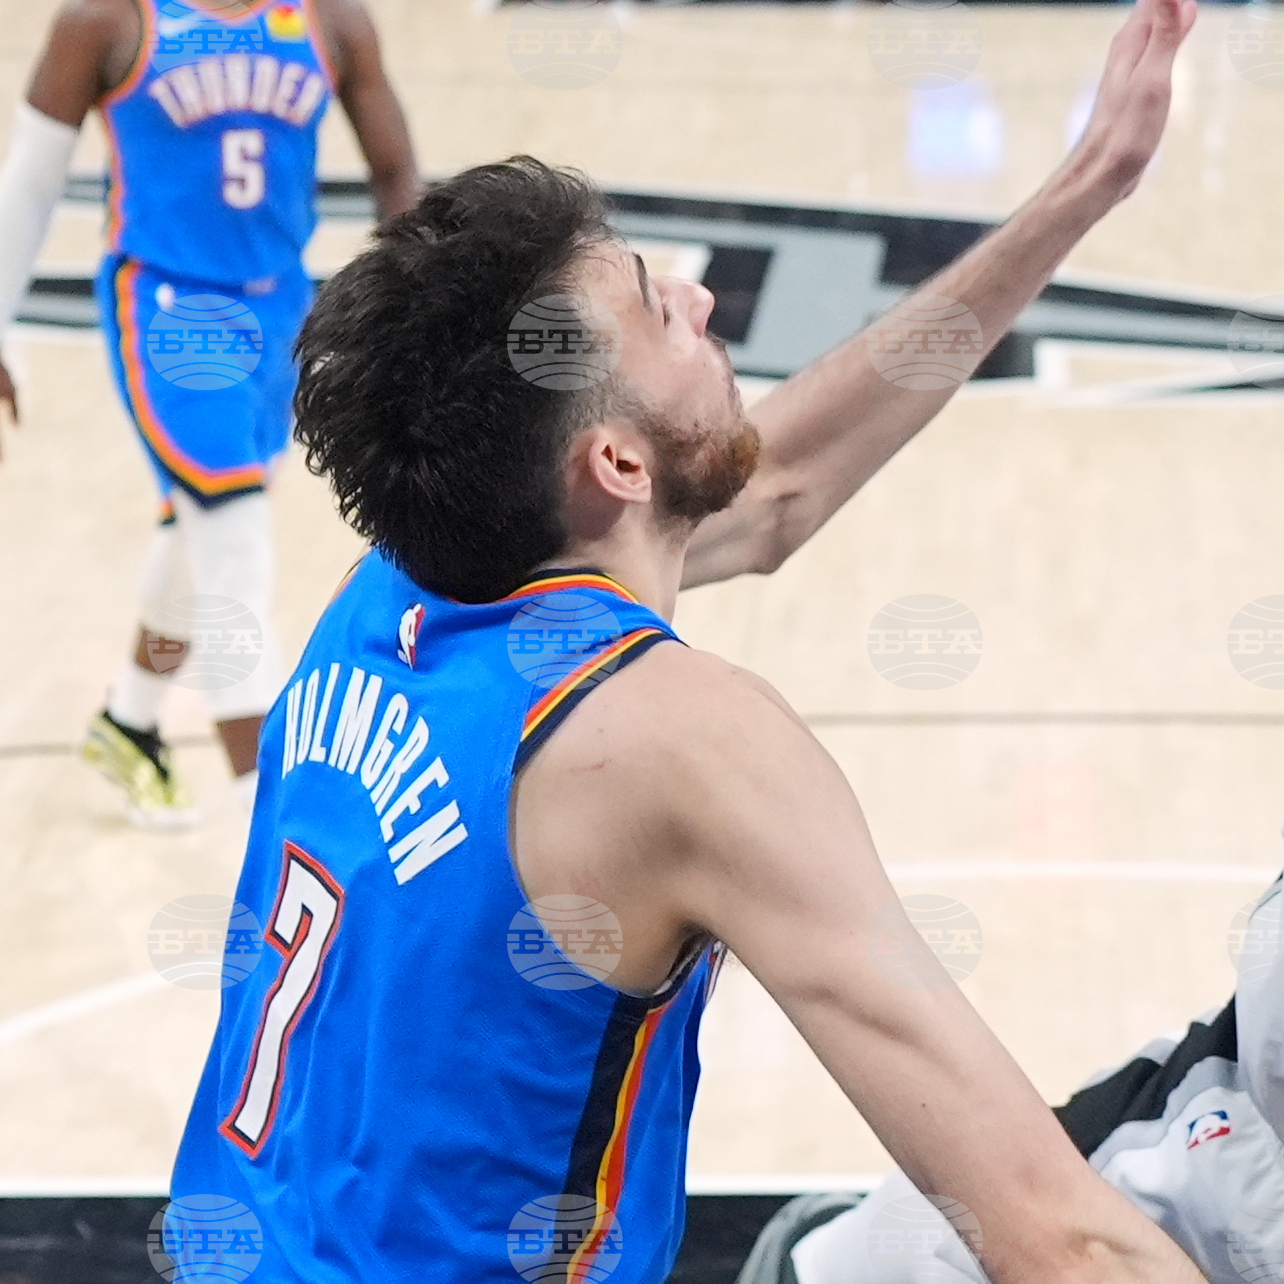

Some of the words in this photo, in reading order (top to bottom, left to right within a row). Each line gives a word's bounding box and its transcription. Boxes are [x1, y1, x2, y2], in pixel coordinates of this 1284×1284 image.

[148, 52, 326, 129] THUNDER
[221, 127, 266, 211] 5
[281, 661, 470, 886] HOLMGREN
[218, 839, 345, 1160] 7
